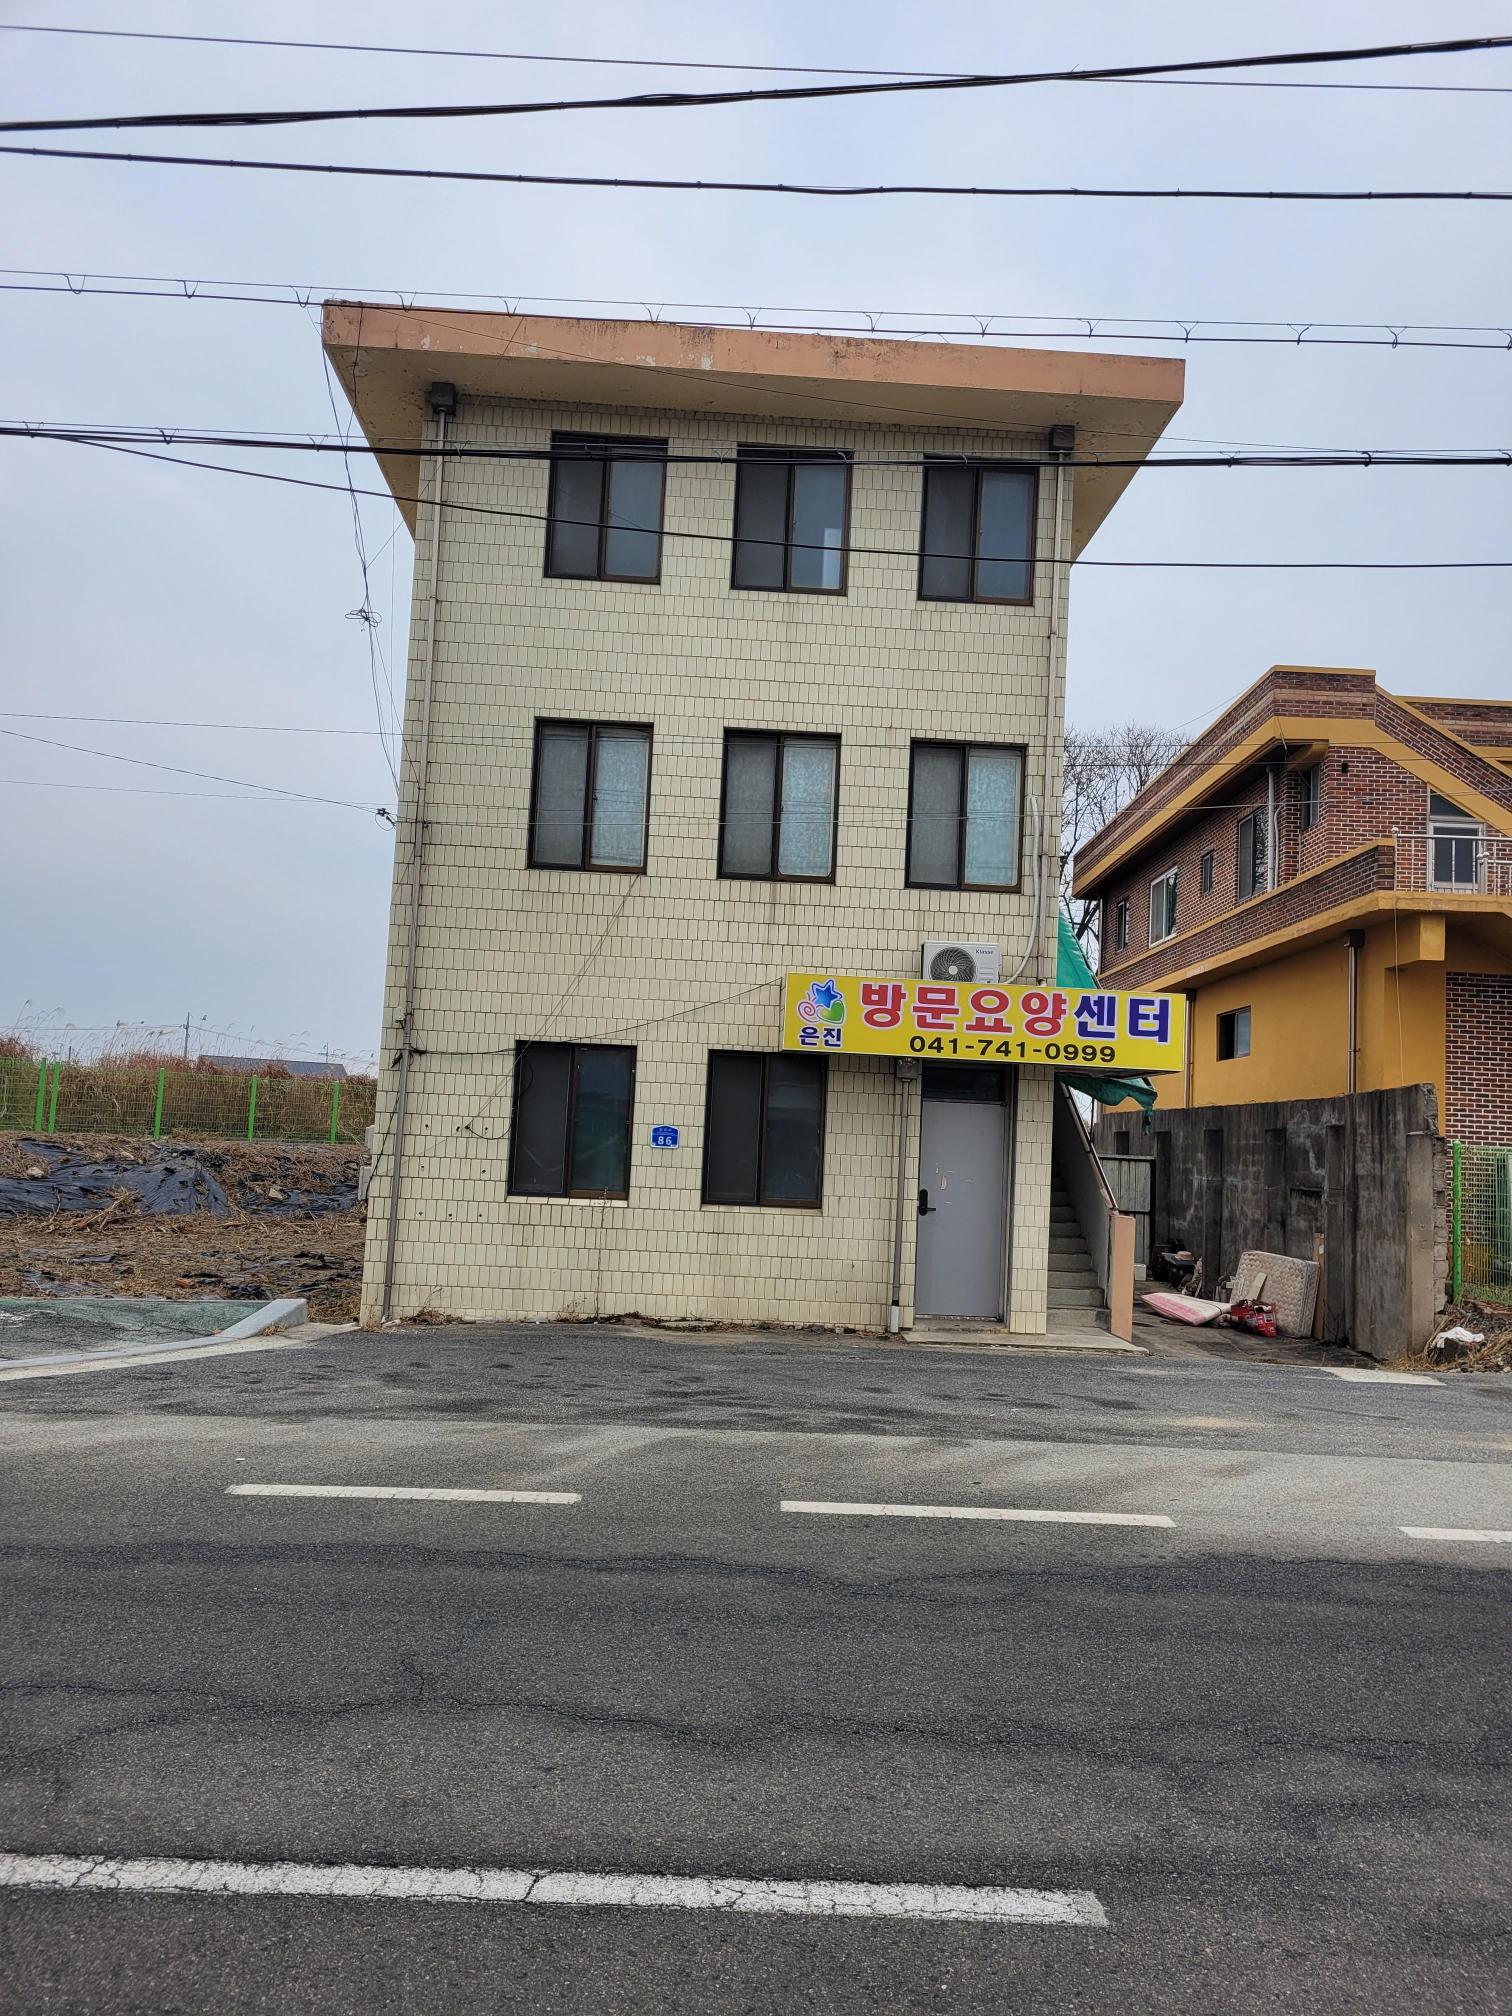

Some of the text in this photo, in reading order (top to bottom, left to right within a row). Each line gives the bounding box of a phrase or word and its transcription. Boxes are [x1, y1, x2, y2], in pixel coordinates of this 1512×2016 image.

[798, 1026, 842, 1047] 은진
[909, 1035, 1116, 1063] 041-741-0999
[657, 1136, 672, 1145] 86
